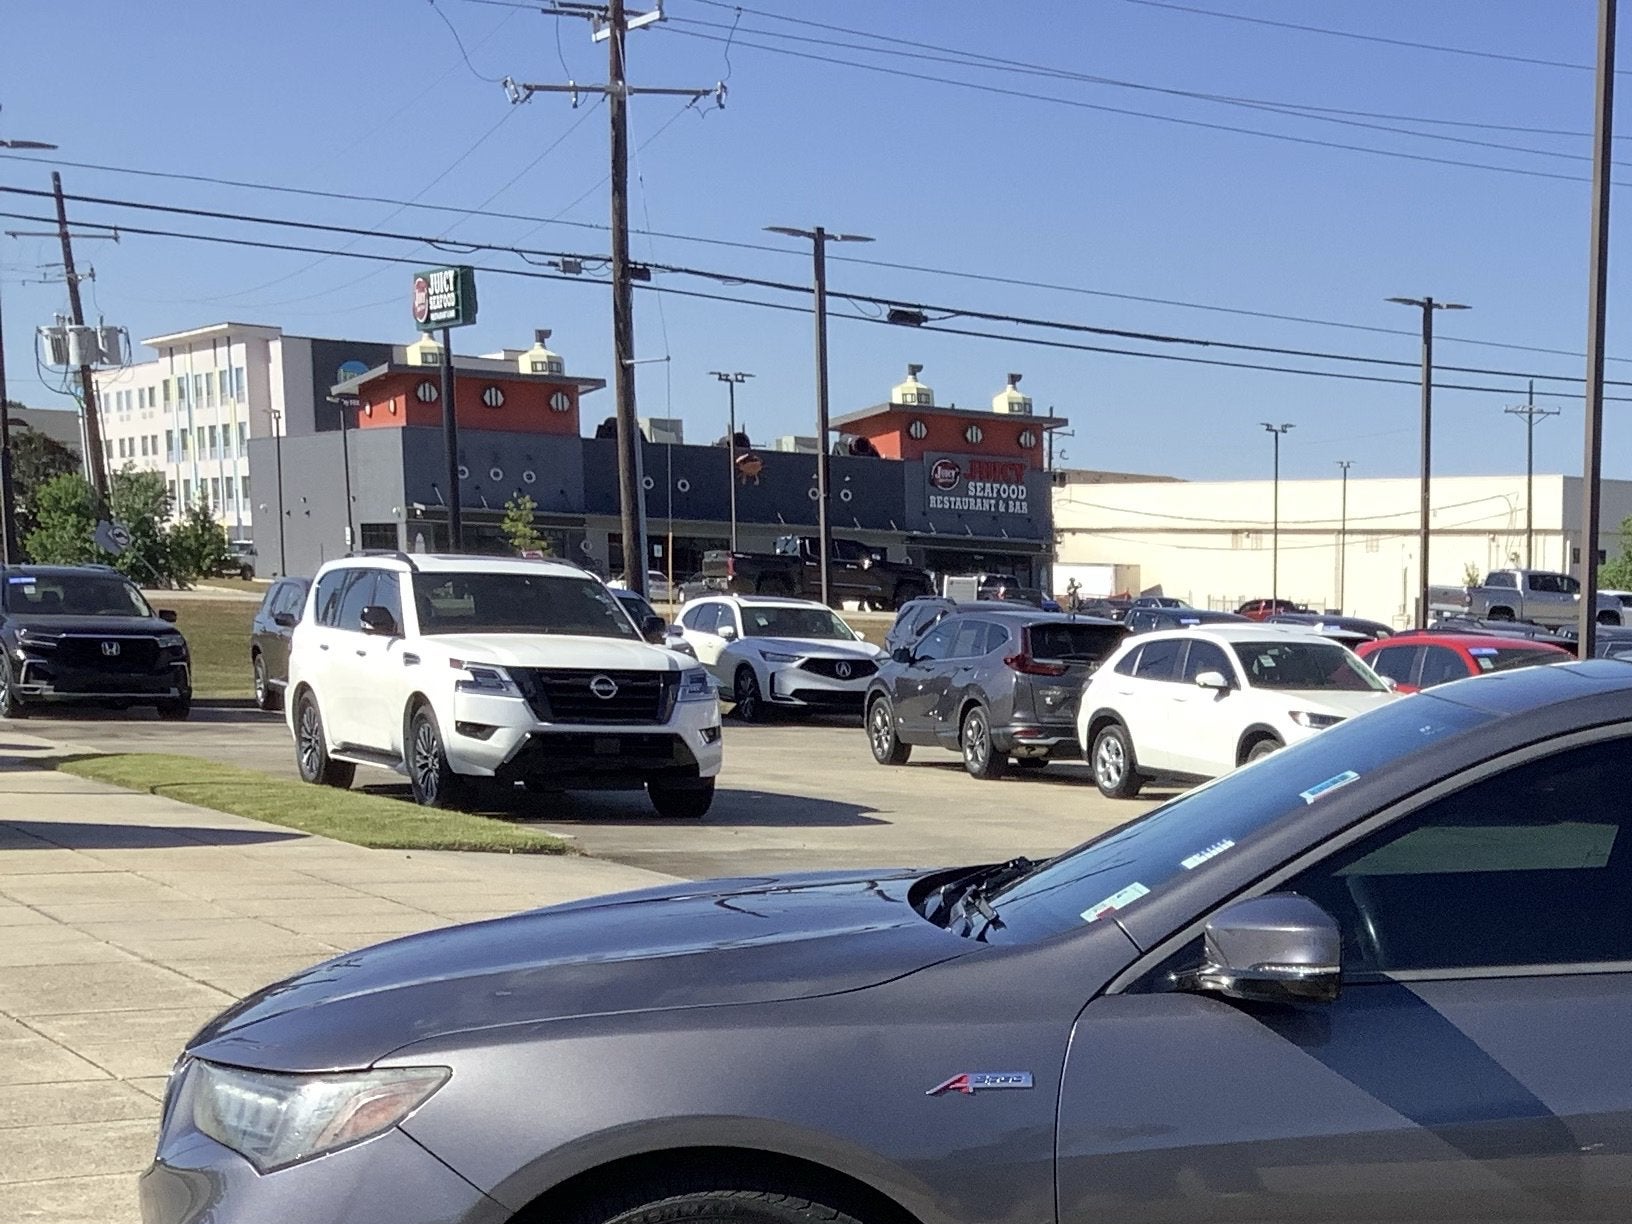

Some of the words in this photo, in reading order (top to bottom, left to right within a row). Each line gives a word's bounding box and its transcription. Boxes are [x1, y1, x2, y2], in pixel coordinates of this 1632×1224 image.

[429, 269, 455, 296] JUICY
[963, 460, 1025, 484] JUICY
[968, 481, 1027, 500] SEAFOOD
[930, 496, 996, 512] RESTAURANT
[998, 500, 1006, 513] &
[1008, 500, 1029, 514] BAR
